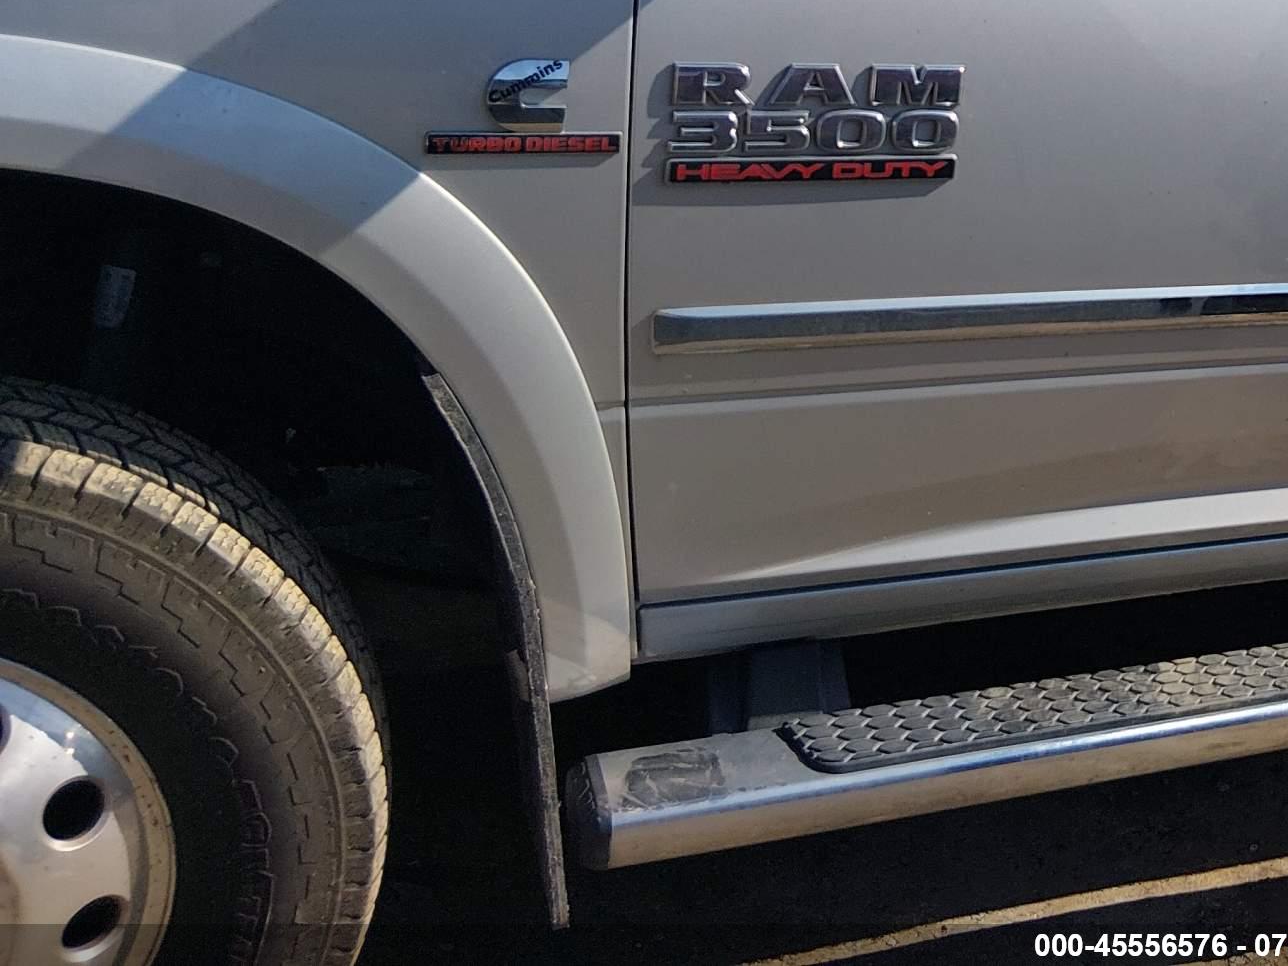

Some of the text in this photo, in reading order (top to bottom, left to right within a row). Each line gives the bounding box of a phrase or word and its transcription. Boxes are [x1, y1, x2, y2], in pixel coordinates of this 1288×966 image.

[488, 58, 563, 104] Cummins
[671, 61, 967, 107] RAM
[432, 136, 617, 153] TURBO DIESEL
[667, 108, 960, 154] 3500
[675, 160, 947, 182] HEAVY DUTY
